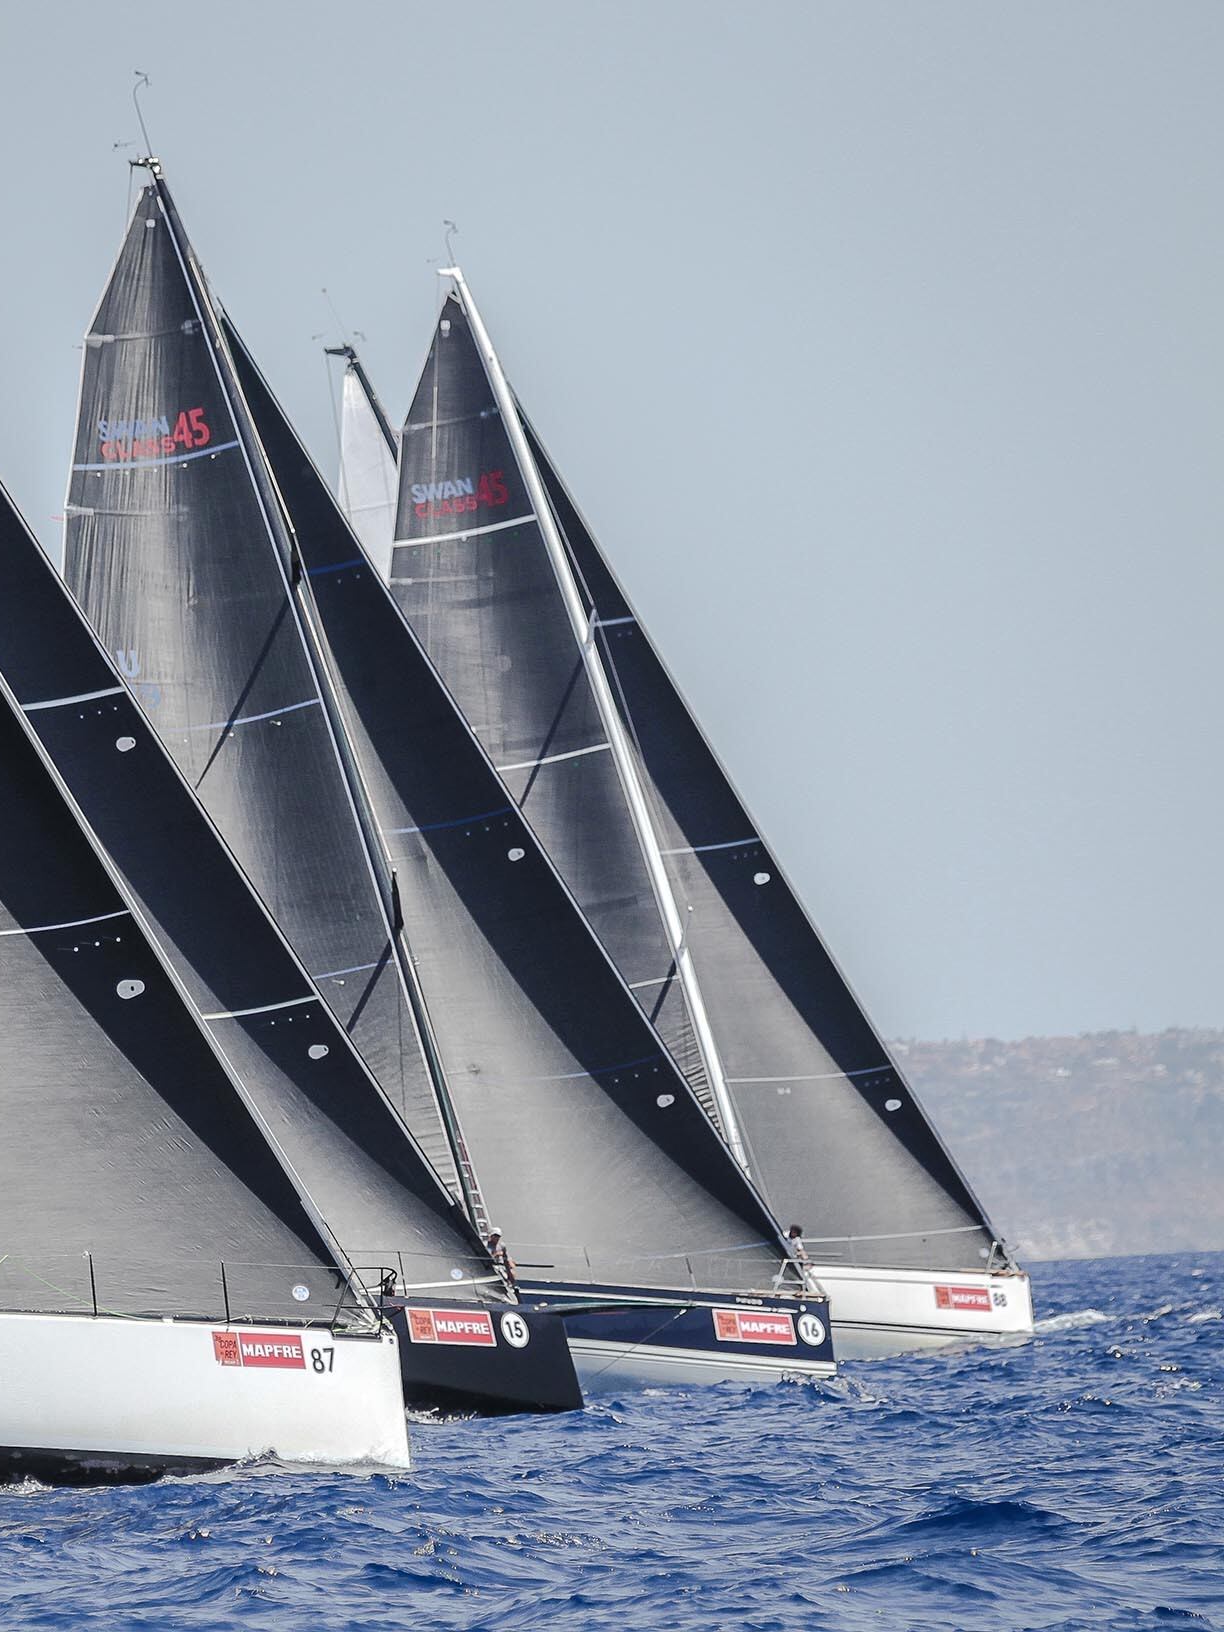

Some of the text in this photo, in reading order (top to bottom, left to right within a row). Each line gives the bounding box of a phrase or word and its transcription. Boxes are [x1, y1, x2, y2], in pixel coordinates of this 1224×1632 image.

[97, 416, 169, 440] SWAN
[101, 408, 210, 459] CLASS 45
[411, 477, 473, 503] SWAN
[415, 470, 508, 518] CLASS 45
[436, 1320, 490, 1335] MAPFRE
[505, 1321, 523, 1338] 15
[740, 1321, 791, 1335] MAPFRE
[802, 1321, 819, 1337] 16
[225, 1350, 237, 1359] REY
[241, 1343, 302, 1359] MAPFRE
[311, 1347, 335, 1374] 87
